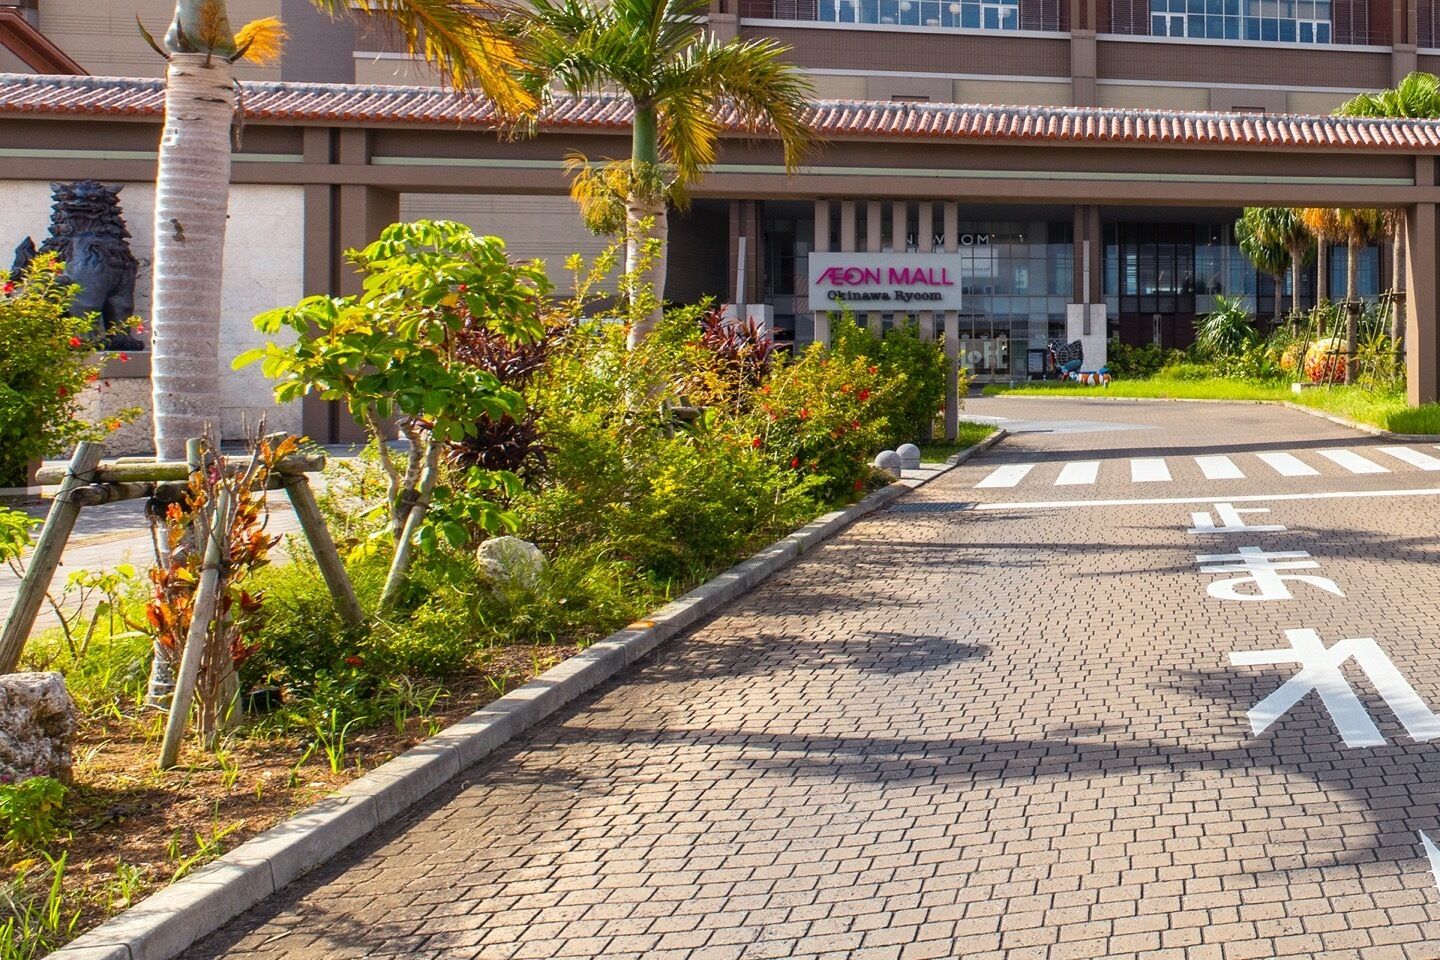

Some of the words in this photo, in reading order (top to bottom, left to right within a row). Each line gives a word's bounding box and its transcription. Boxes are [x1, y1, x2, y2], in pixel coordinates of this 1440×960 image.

[888, 267, 954, 286] MALL
[827, 290, 891, 301] Okinawa
[894, 290, 943, 303] Rycom
